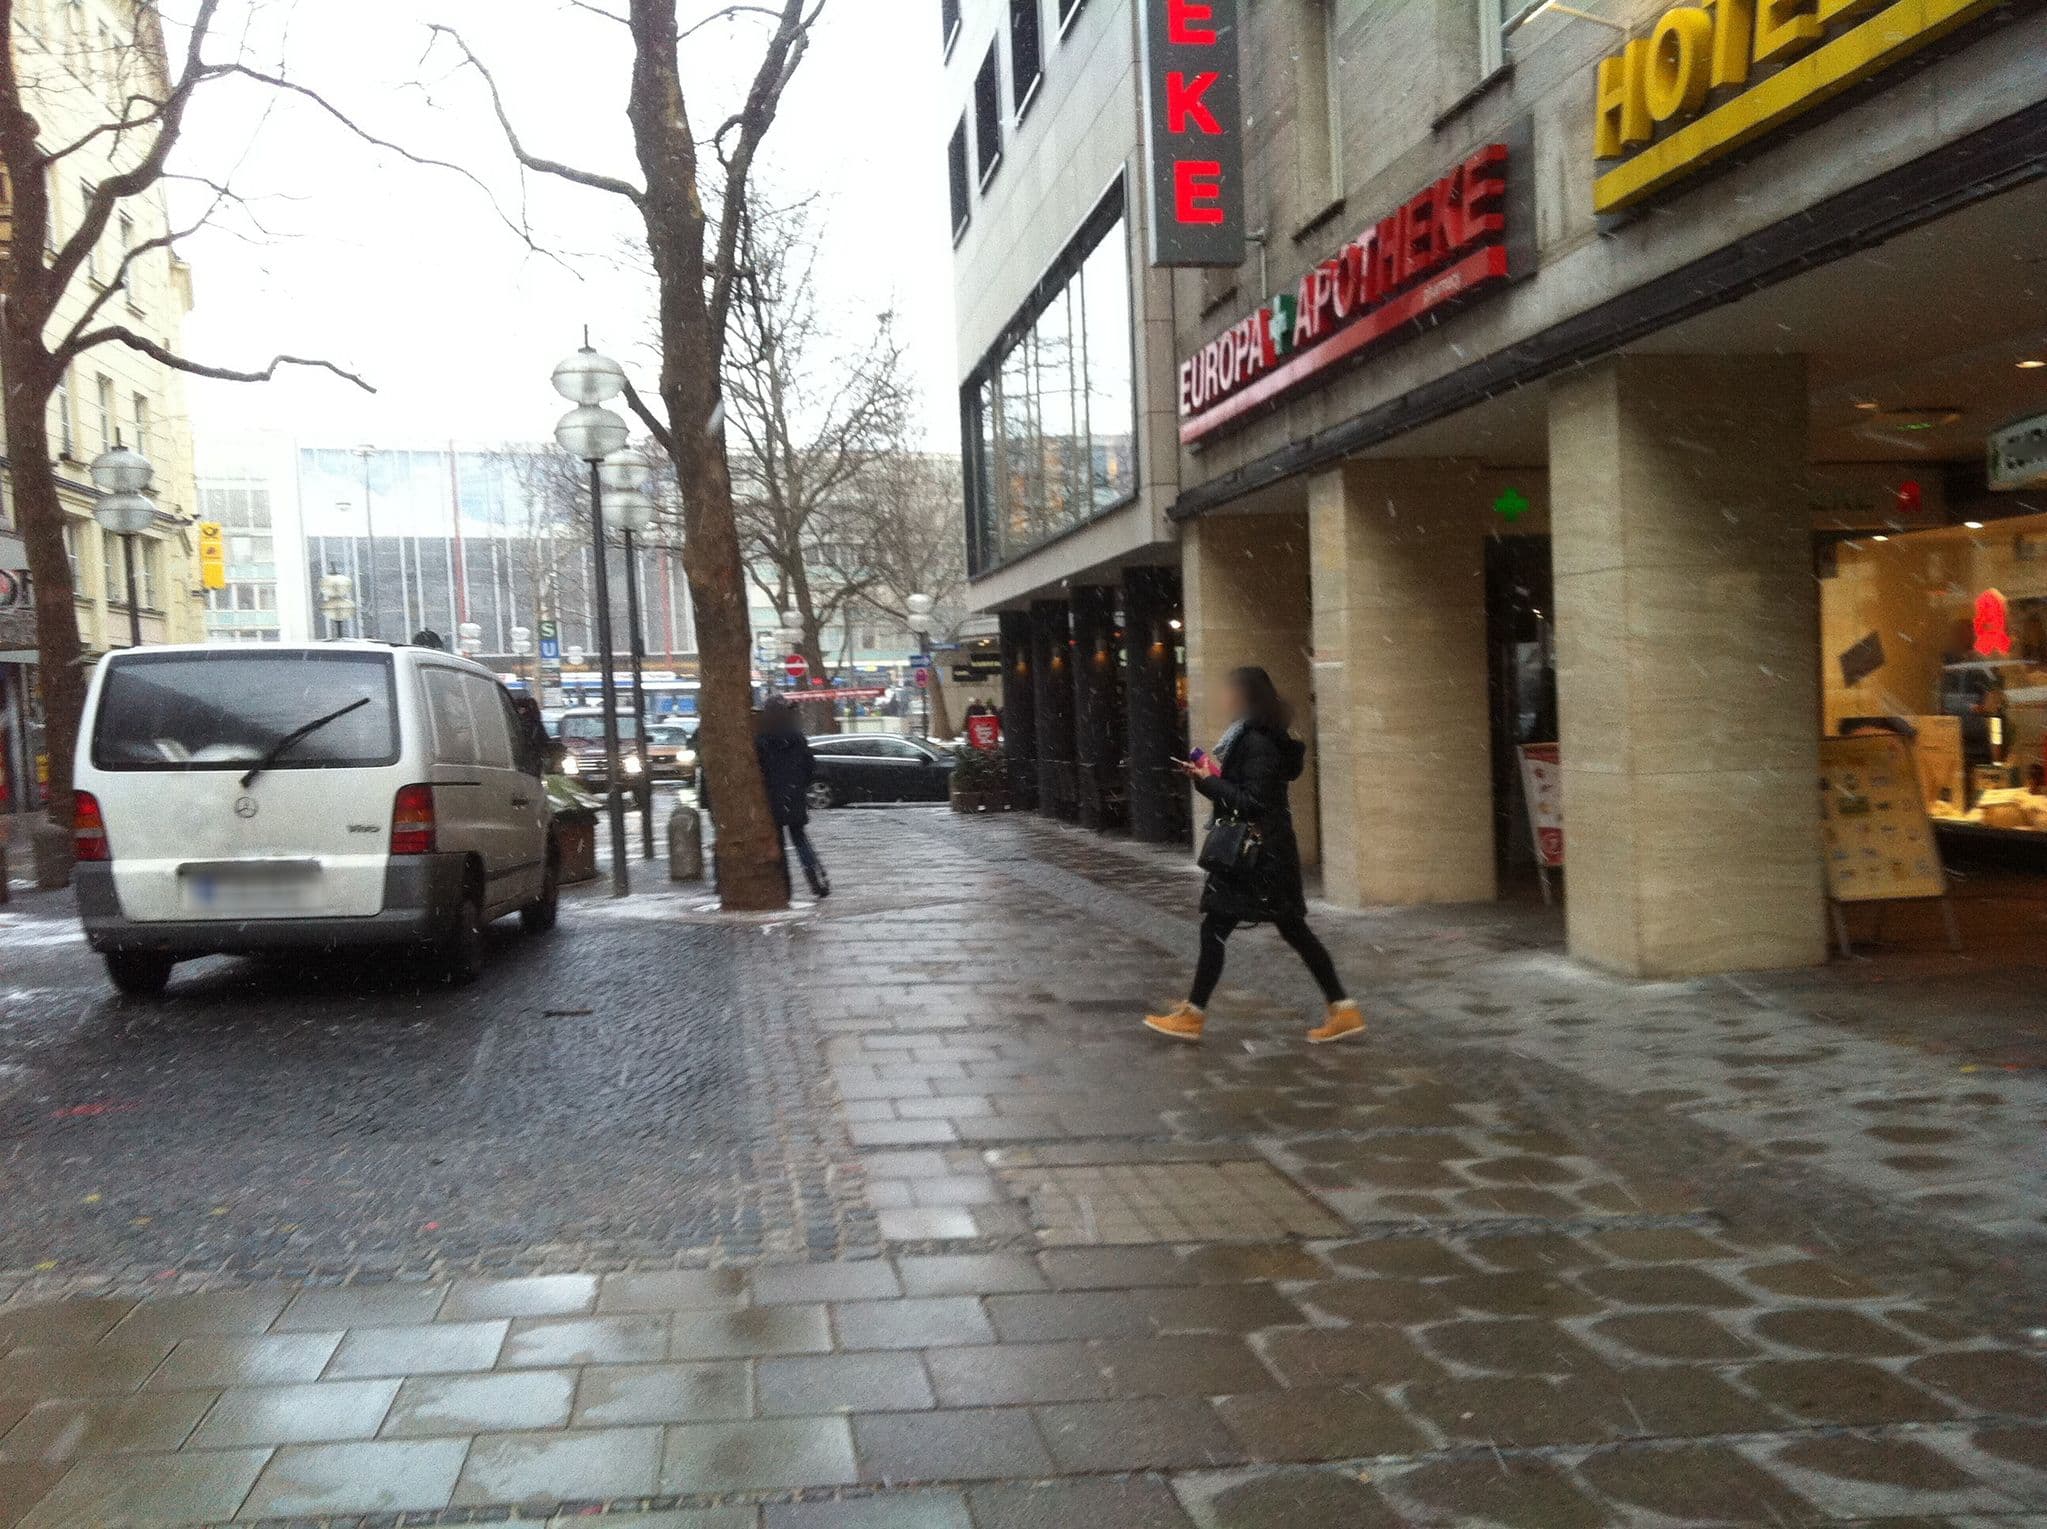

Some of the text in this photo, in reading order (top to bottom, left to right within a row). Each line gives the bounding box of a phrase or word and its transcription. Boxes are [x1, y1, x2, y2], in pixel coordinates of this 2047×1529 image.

[1594, 0, 1858, 160] HOTE
[1178, 144, 1508, 416] EUROPA APOTHEKE
[541, 622, 555, 637] S
[542, 642, 557, 657] U
